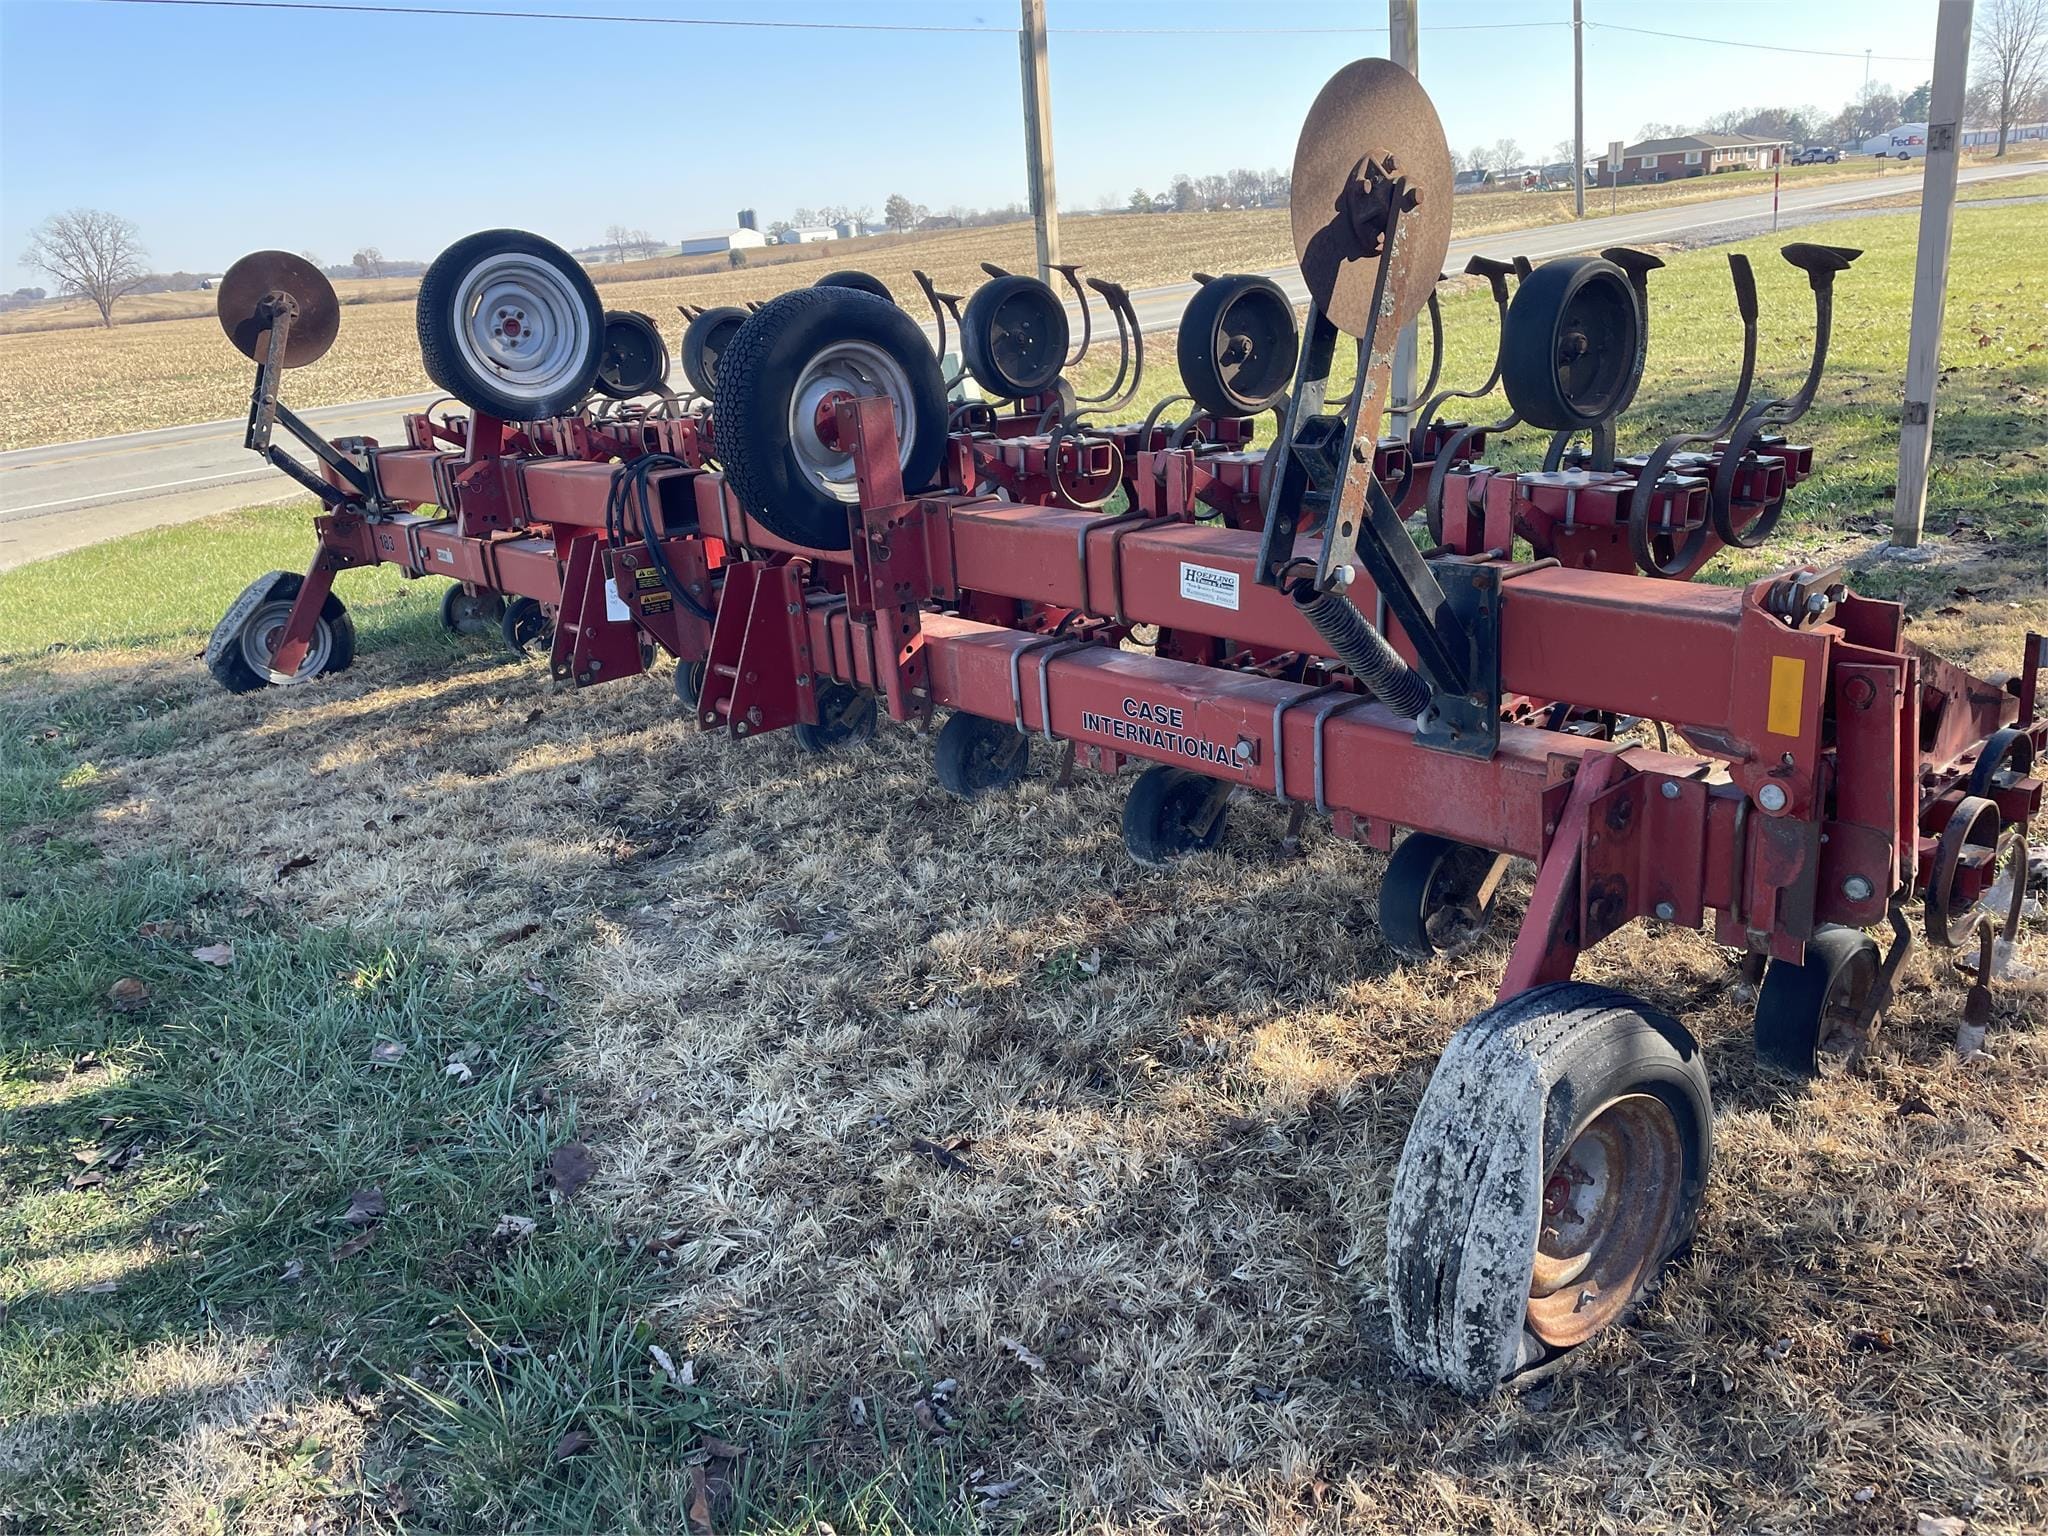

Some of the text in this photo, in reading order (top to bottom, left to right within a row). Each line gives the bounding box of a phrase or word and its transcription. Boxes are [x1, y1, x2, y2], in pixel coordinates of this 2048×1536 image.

[1891, 135, 1925, 147] FedEx
[1185, 568, 1235, 584] HOEFLING
[1123, 697, 1183, 729] CASE
[1082, 711, 1243, 769] INTERNATIONAL
